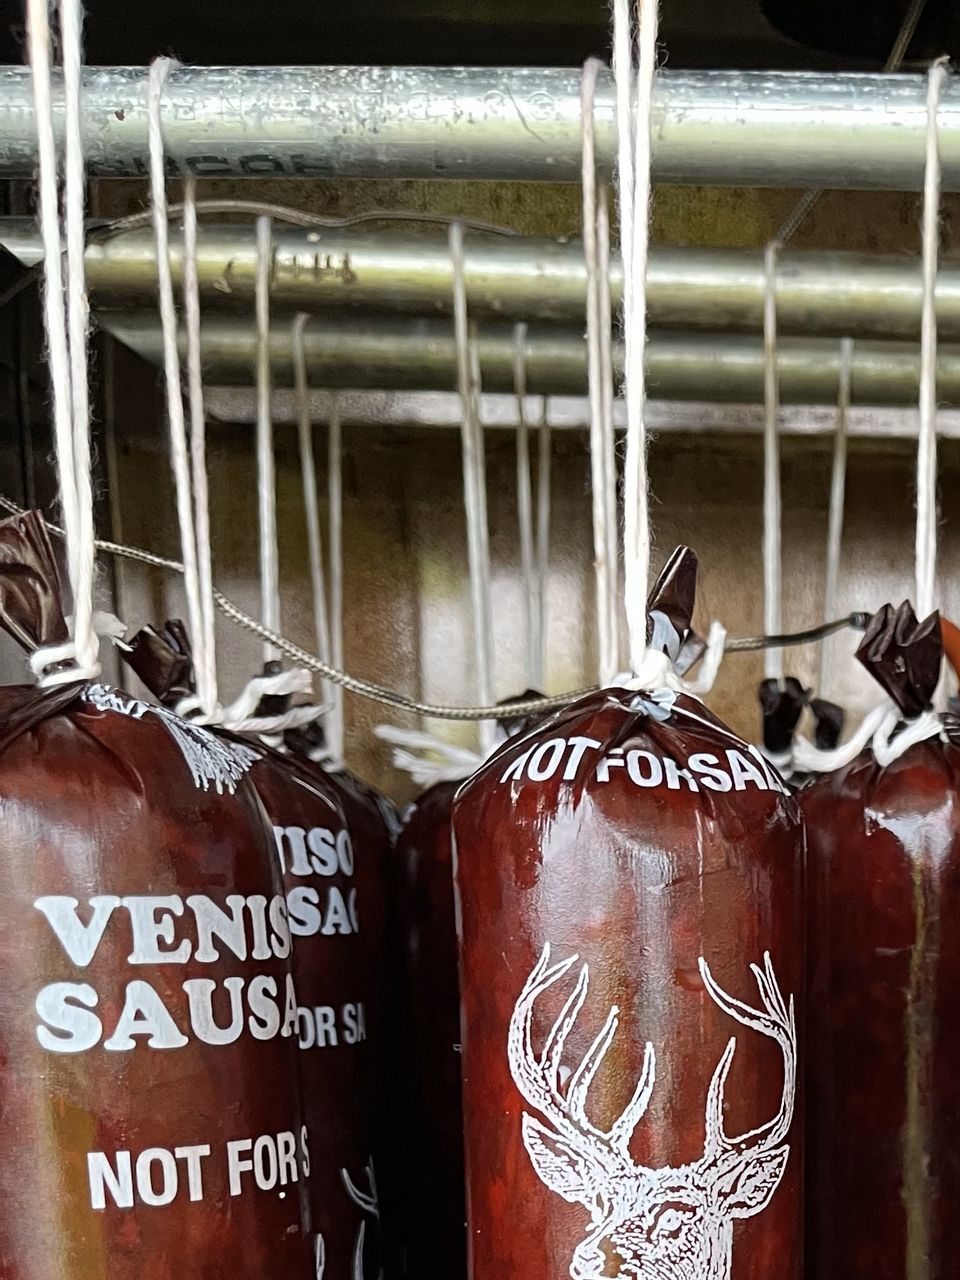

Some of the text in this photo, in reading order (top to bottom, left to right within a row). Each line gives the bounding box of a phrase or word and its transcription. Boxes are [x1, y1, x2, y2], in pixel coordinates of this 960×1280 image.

[596, 748, 700, 793] FOR
[34, 894, 293, 967] VENIS
[36, 973, 300, 1053] SAUSA
[87, 1144, 210, 1210] NOT
[227, 1130, 299, 1197] FOR
